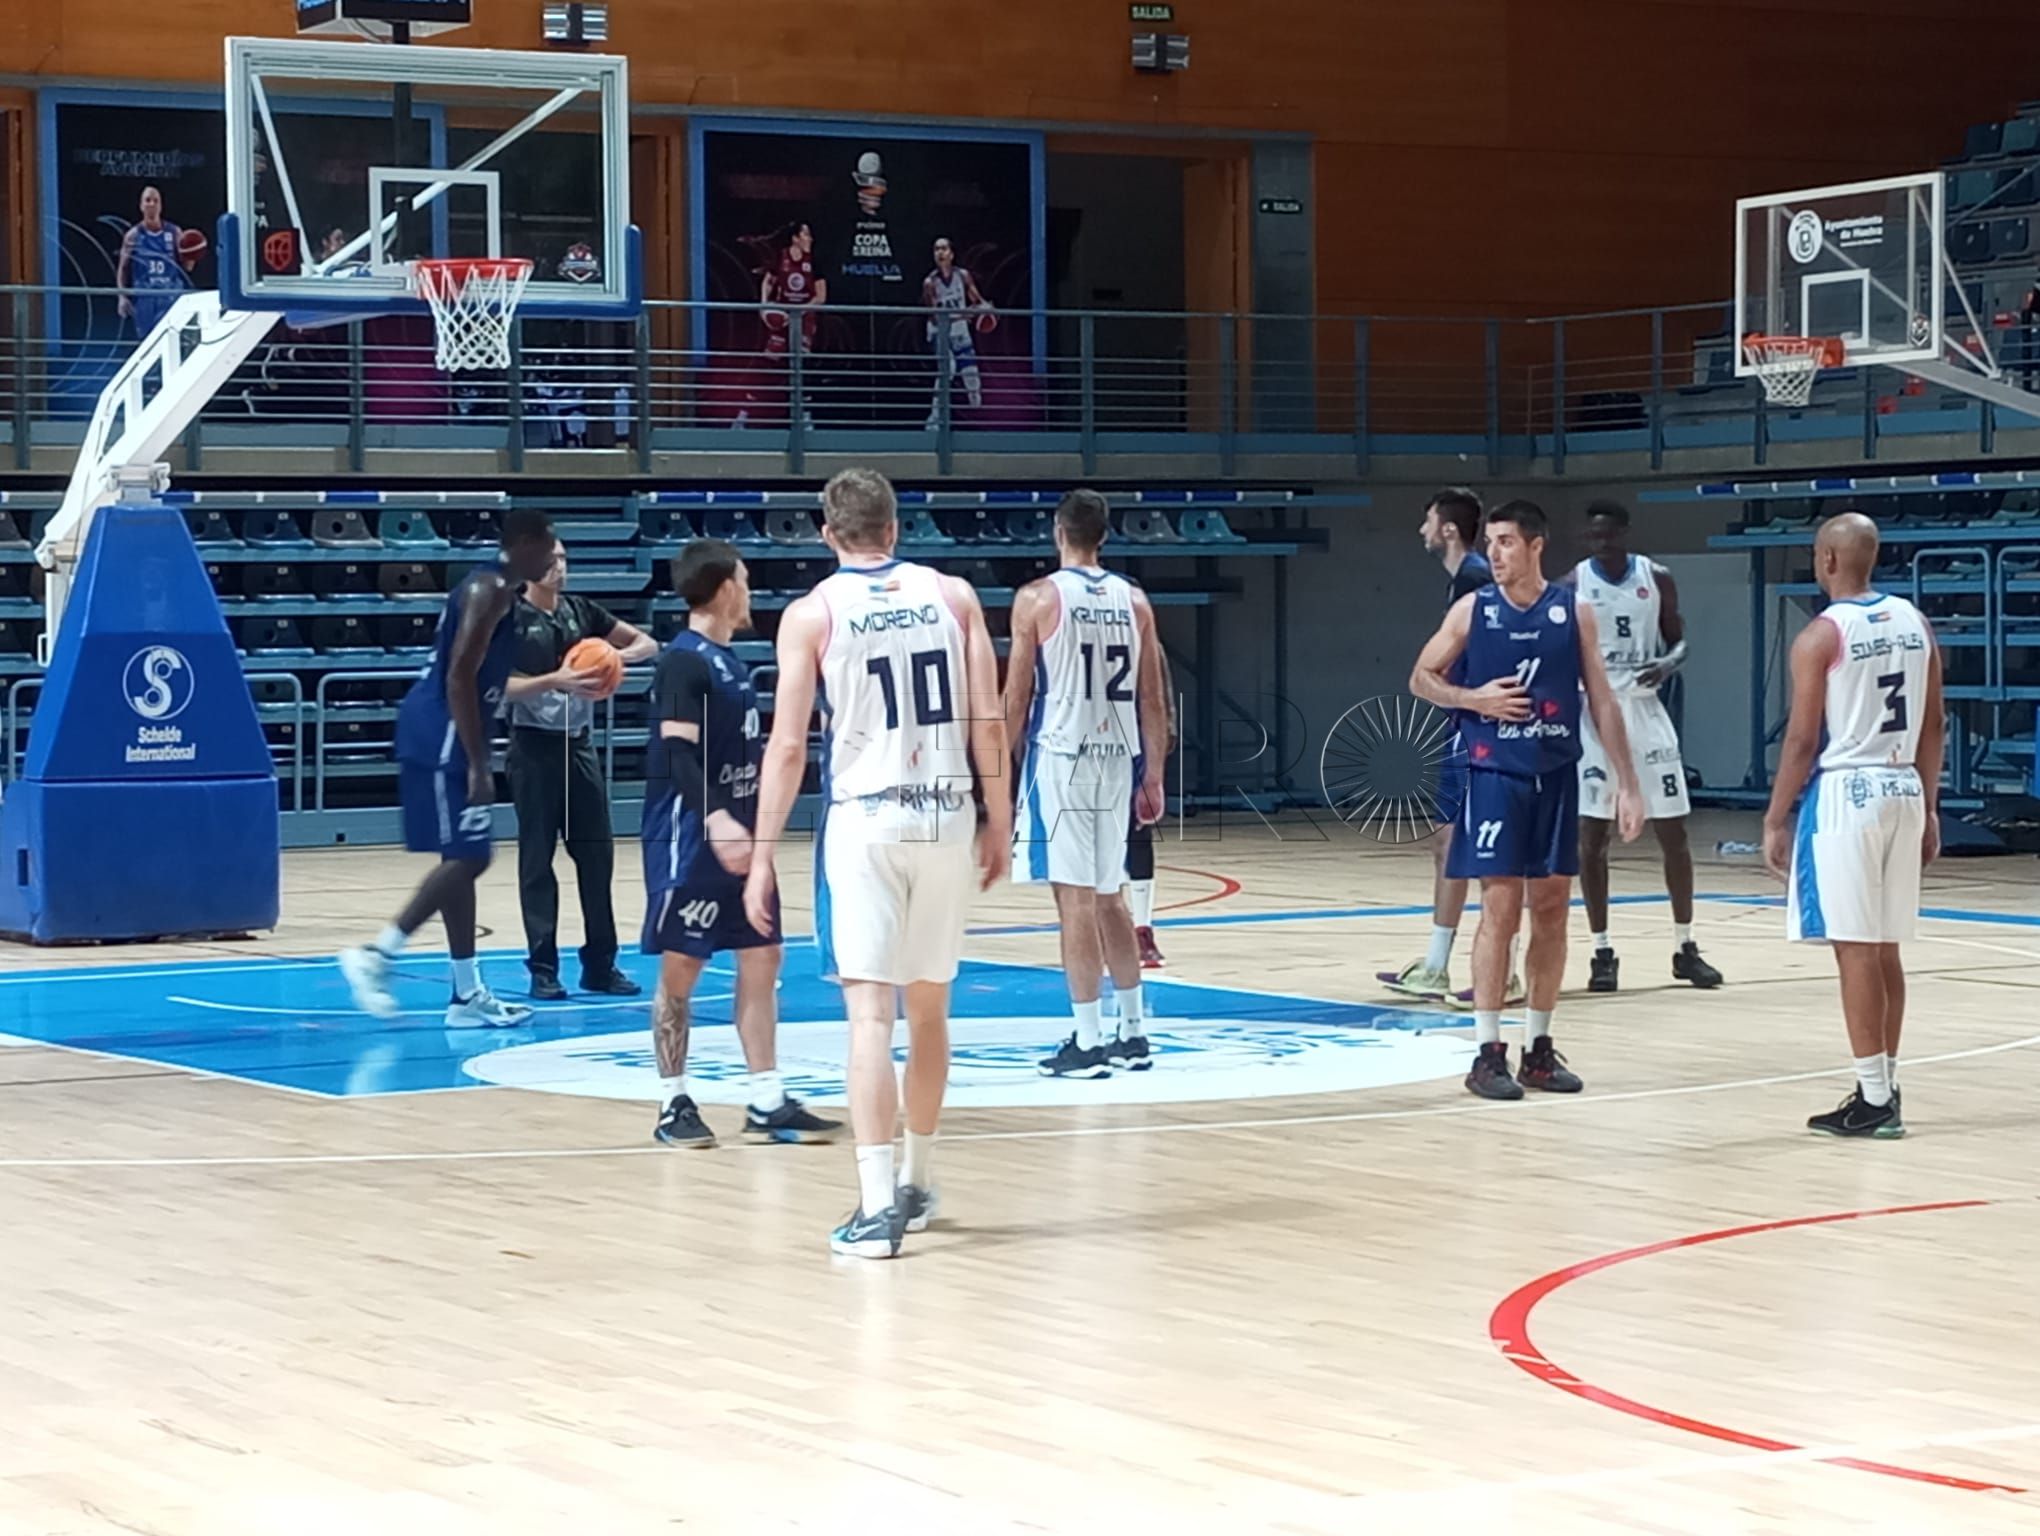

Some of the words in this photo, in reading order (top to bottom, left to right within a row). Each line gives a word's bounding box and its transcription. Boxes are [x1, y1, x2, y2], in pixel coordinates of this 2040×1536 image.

[1132, 6, 1171, 19] SALIDA
[855, 234, 888, 246] COPA
[849, 604, 939, 638] MORENO
[1615, 616, 1632, 638] 8
[1080, 643, 1133, 701] 12
[866, 648, 953, 730] 10
[1877, 670, 1907, 734] 3
[138, 725, 182, 743] Schelde
[125, 743, 196, 762] International
[1662, 773, 1678, 797] 8
[1476, 820, 1503, 849] 11
[678, 899, 719, 928] 40
